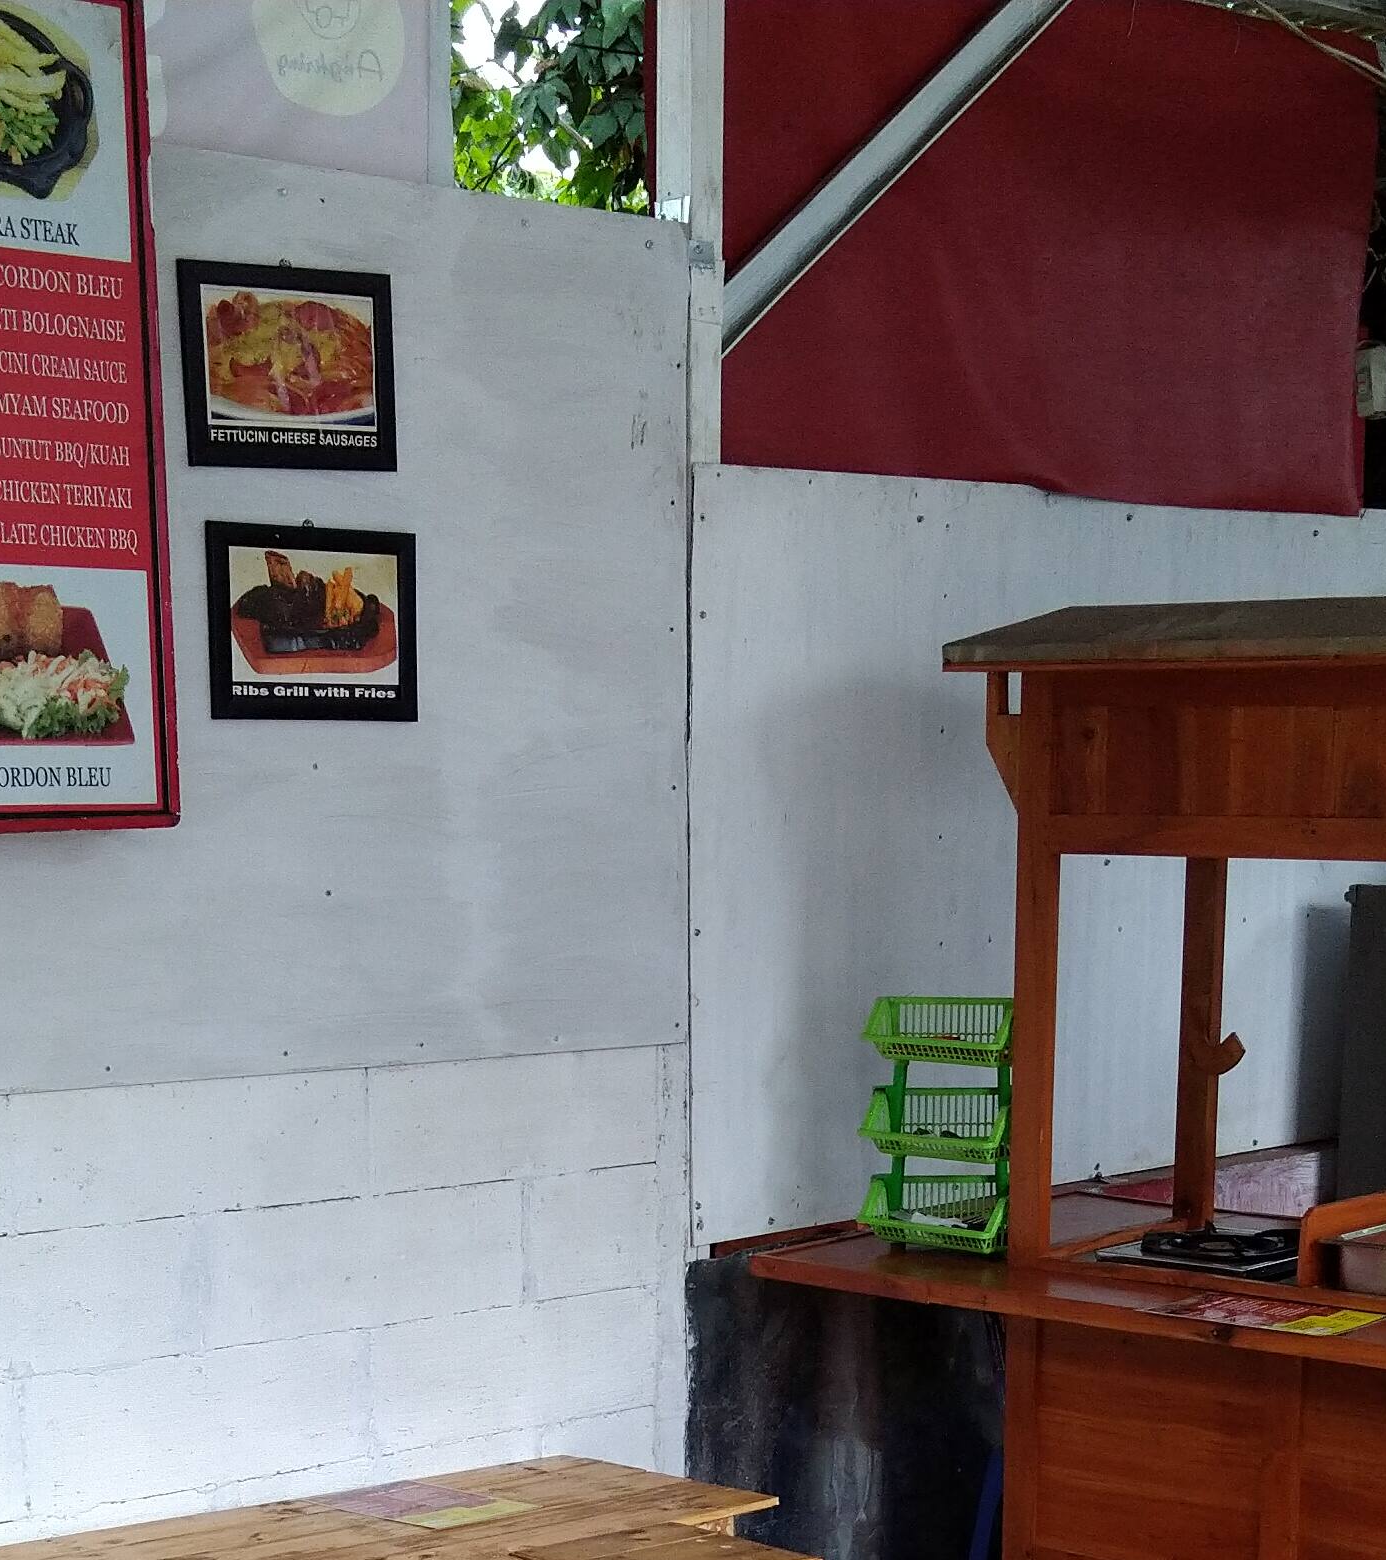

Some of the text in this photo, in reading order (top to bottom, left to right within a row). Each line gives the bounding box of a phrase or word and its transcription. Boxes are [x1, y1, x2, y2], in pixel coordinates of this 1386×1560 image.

[21, 213, 80, 246] STEAK
[76, 273, 123, 300] BLEU
[23, 310, 126, 343] BOLOGNAISE
[31, 353, 80, 380] CREAM
[83, 358, 127, 384] SAUCE
[51, 397, 129, 424] SEAFOOD
[210, 429, 377, 448] FETTUCINI CHEESE SAUSAGES
[55, 441, 130, 469] BBQ/KUAH
[63, 483, 133, 510] TERIYAKI
[40, 525, 105, 549] CHICKEN
[109, 528, 138, 556] BBQ
[232, 684, 396, 699] Ribs Grill with Fries
[66, 766, 112, 788] BLEU
